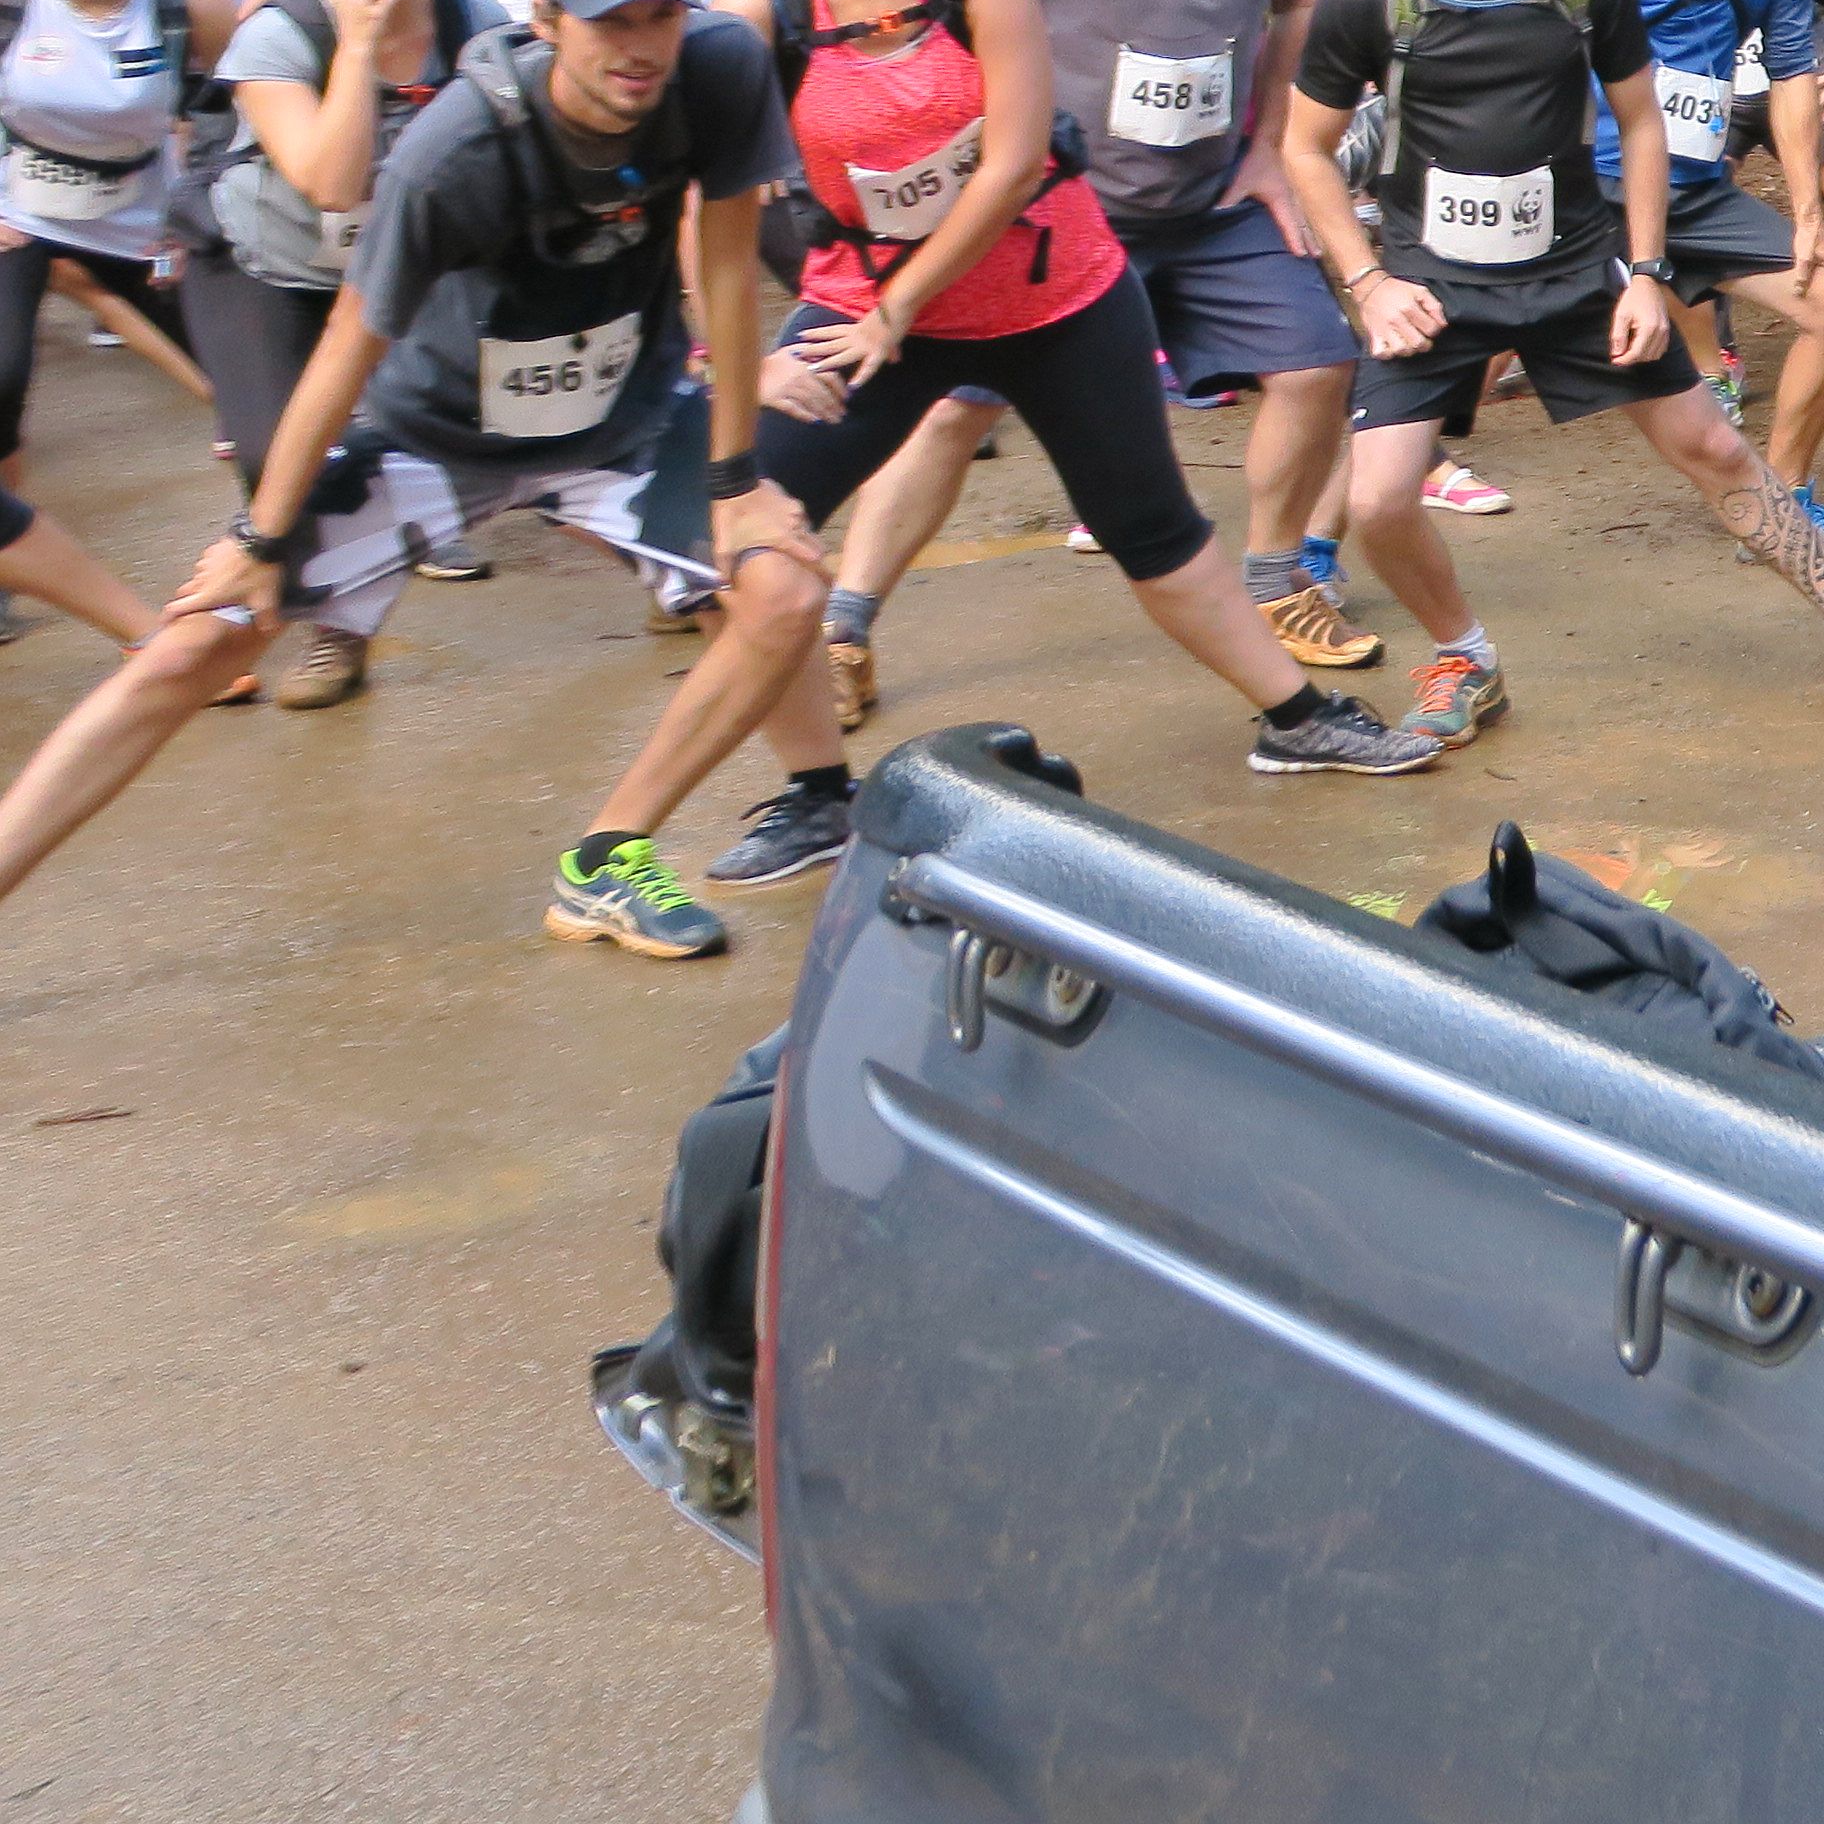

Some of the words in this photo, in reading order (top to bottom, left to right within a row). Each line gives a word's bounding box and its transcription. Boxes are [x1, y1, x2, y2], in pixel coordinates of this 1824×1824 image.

[1131, 79, 1192, 110] 458
[1663, 92, 1713, 124] 403
[873, 166, 942, 210] 705
[1440, 195, 1502, 227] 399
[502, 360, 582, 397] 456
